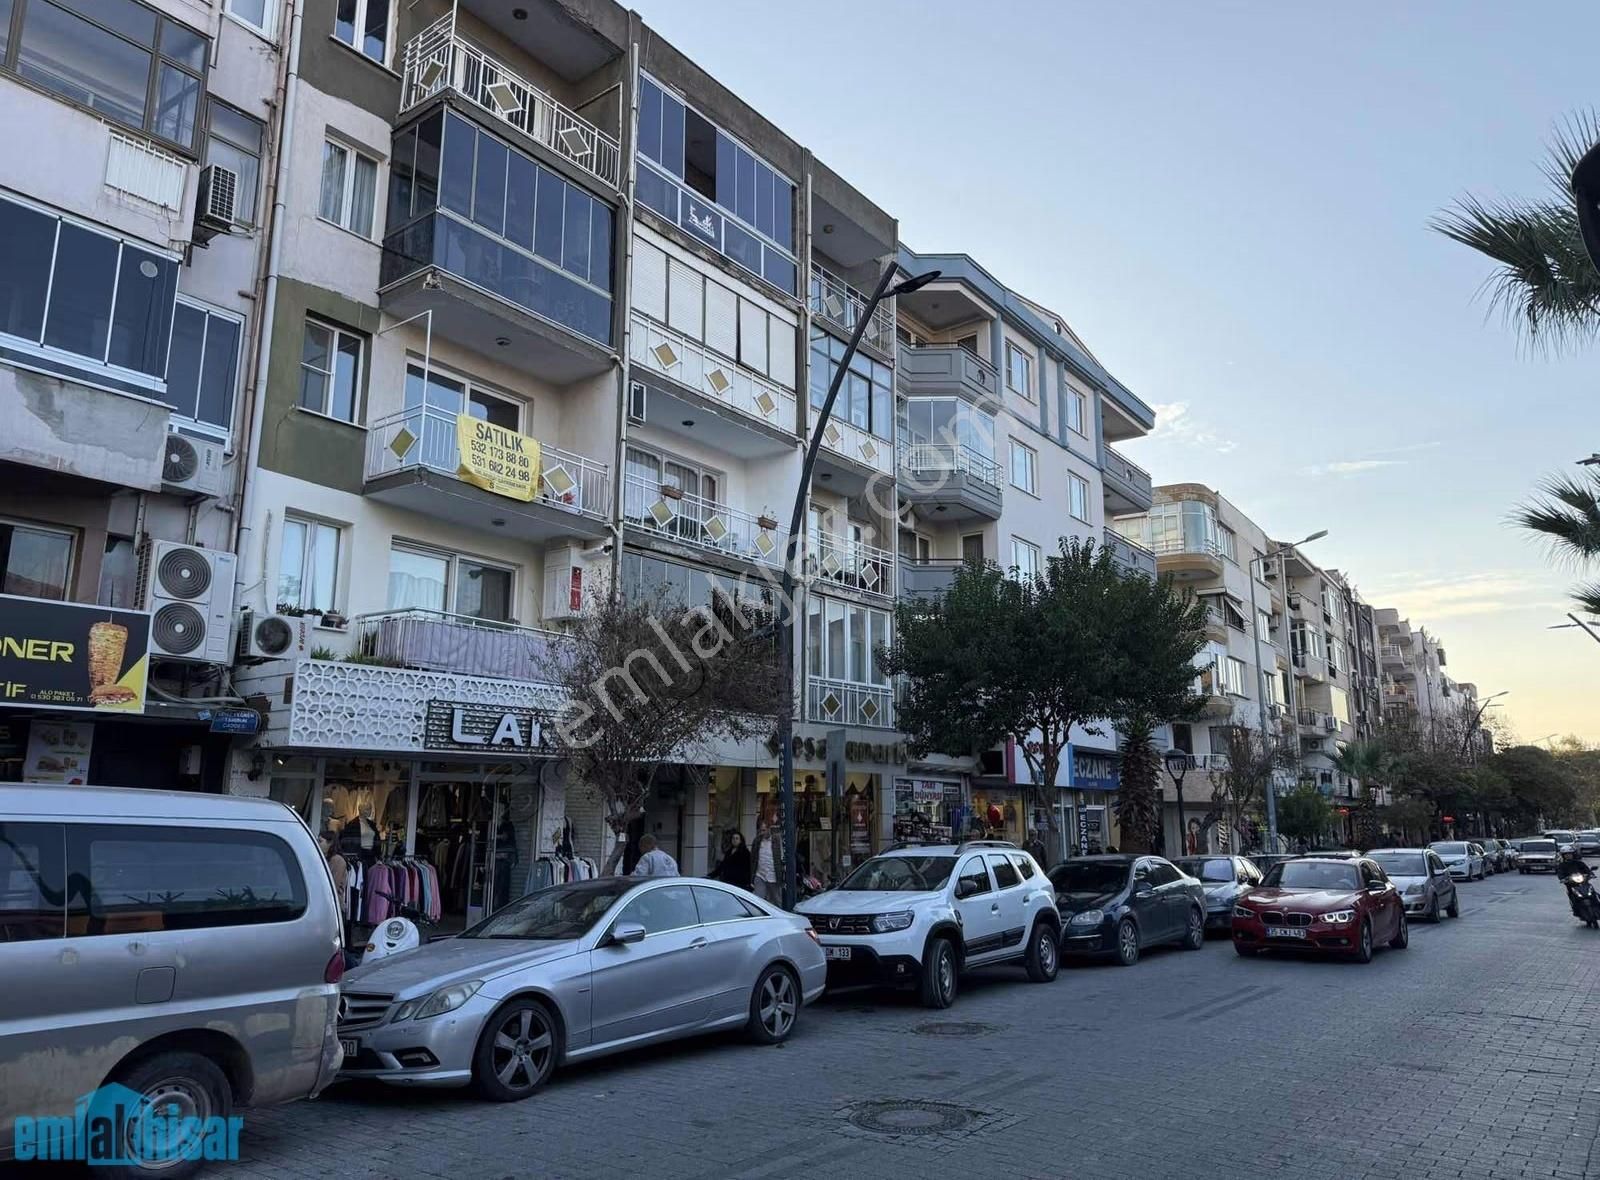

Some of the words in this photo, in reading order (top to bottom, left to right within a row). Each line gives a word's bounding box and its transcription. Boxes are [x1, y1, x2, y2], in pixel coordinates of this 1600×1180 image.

[476, 422, 524, 453] SATILIK
[471, 440, 487, 455] 532
[490, 446, 504, 460] 173
[506, 451, 517, 465] 88
[518, 455, 529, 468] 80
[472, 453, 486, 468] 531
[505, 465, 516, 479] 24
[518, 469, 530, 482] 98
[0, 636, 75, 663] NER
[1073, 757, 1112, 780] ECZANE
[1079, 814, 1089, 857] ECZANE
